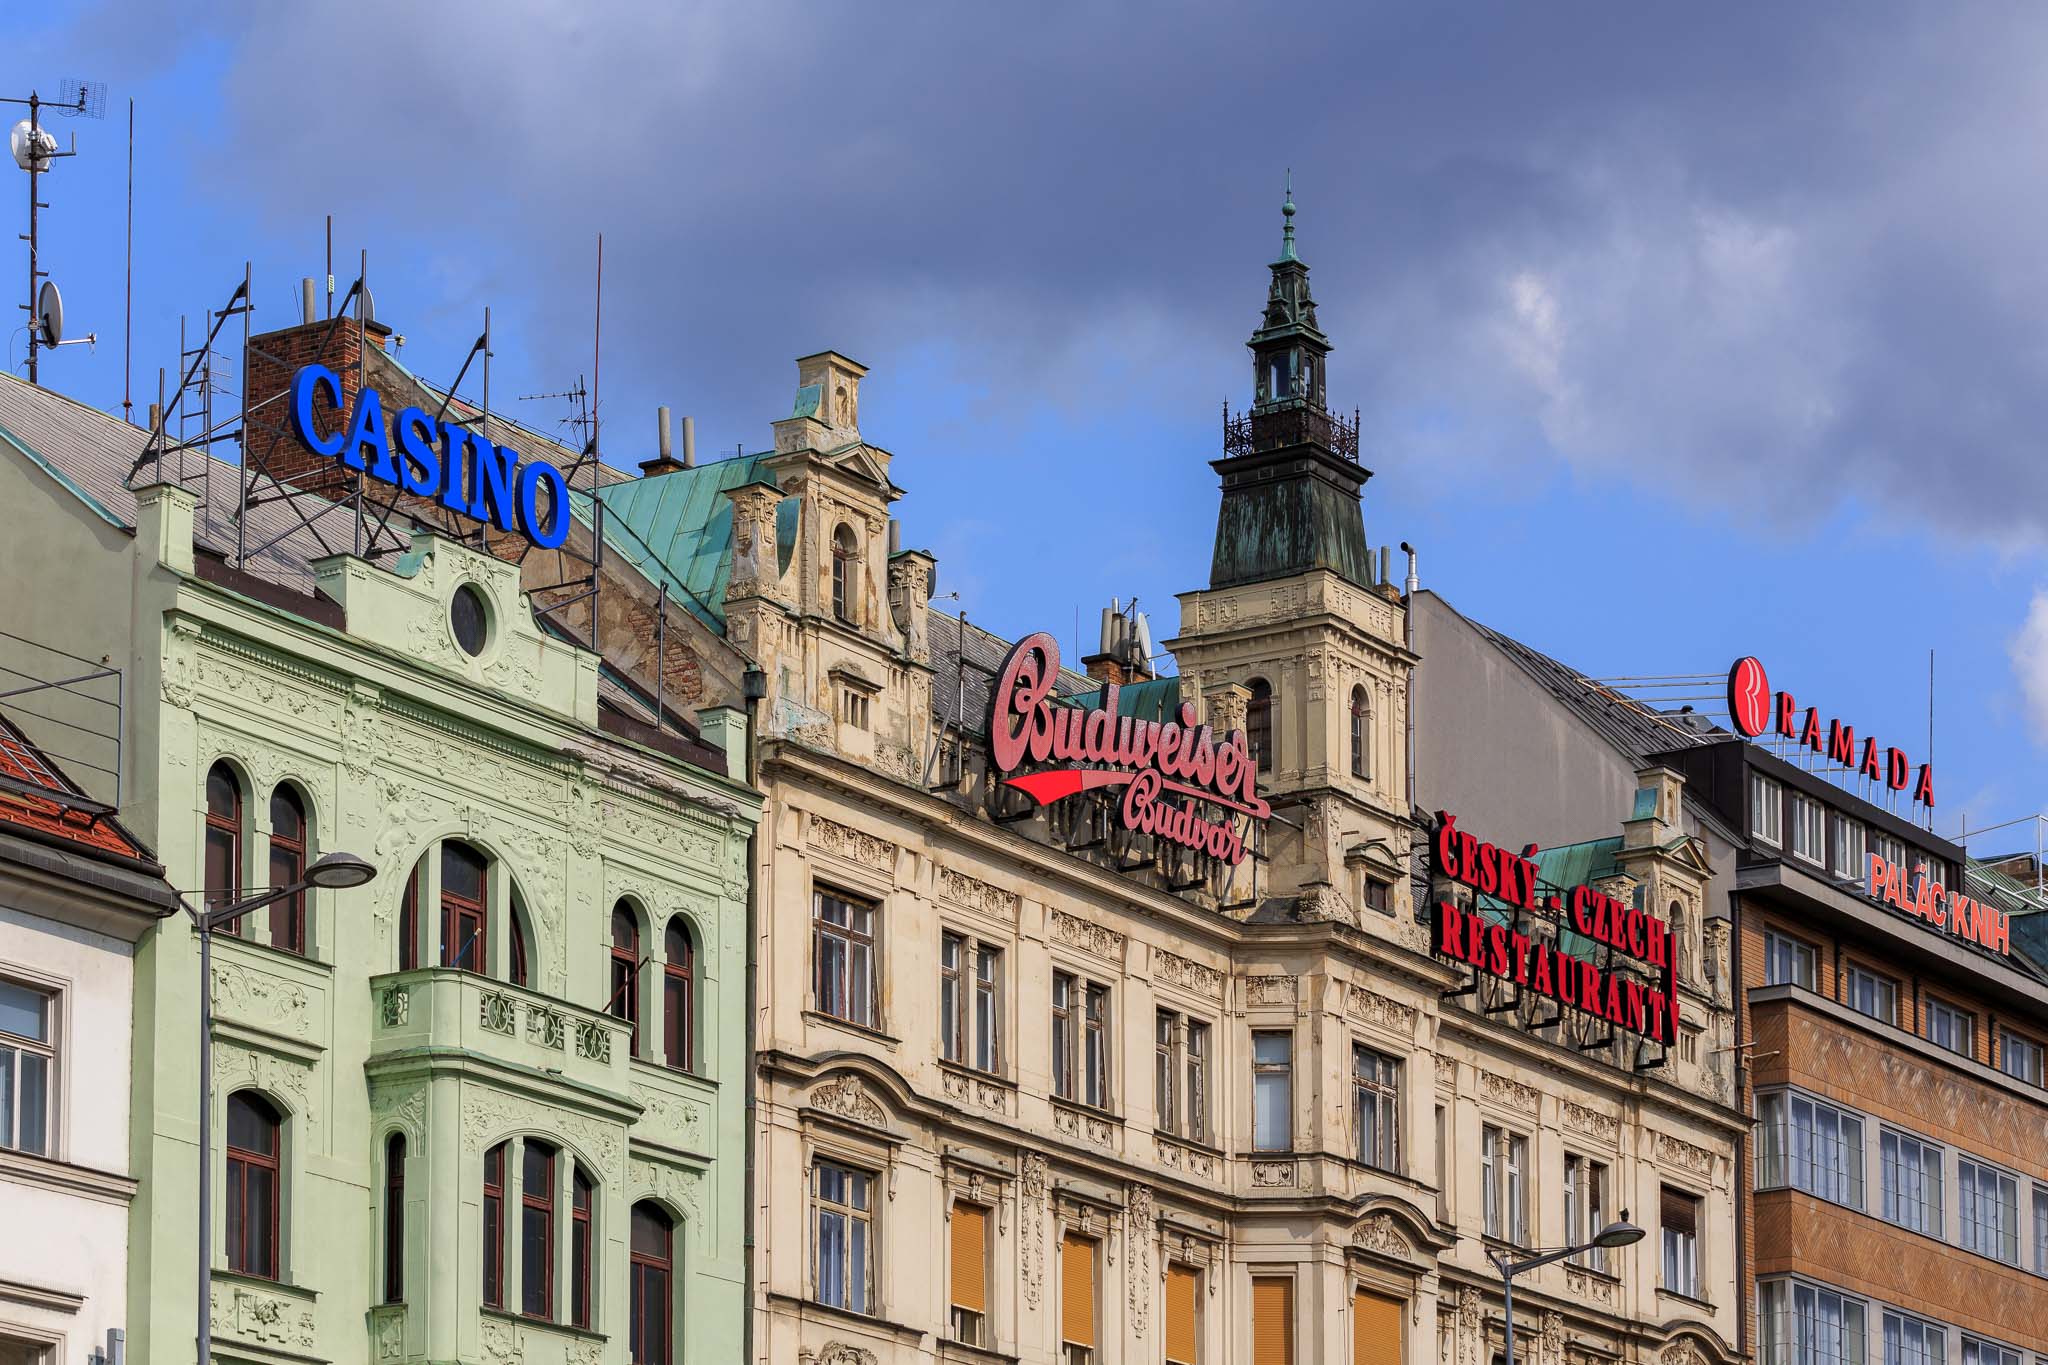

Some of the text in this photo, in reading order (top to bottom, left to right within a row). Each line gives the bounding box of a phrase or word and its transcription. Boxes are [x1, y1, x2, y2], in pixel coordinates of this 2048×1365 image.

[290, 364, 571, 550] CASINO
[991, 632, 1271, 815] Budweiser
[1777, 692, 1935, 808] RAMADA
[1122, 768, 1249, 865] Budvar
[1437, 810, 1540, 912] ČESKÝ
[1572, 884, 1667, 968] CZECH
[1868, 853, 2010, 956] PALÁC KNIH
[1439, 901, 1666, 1042] RESTAURANT
